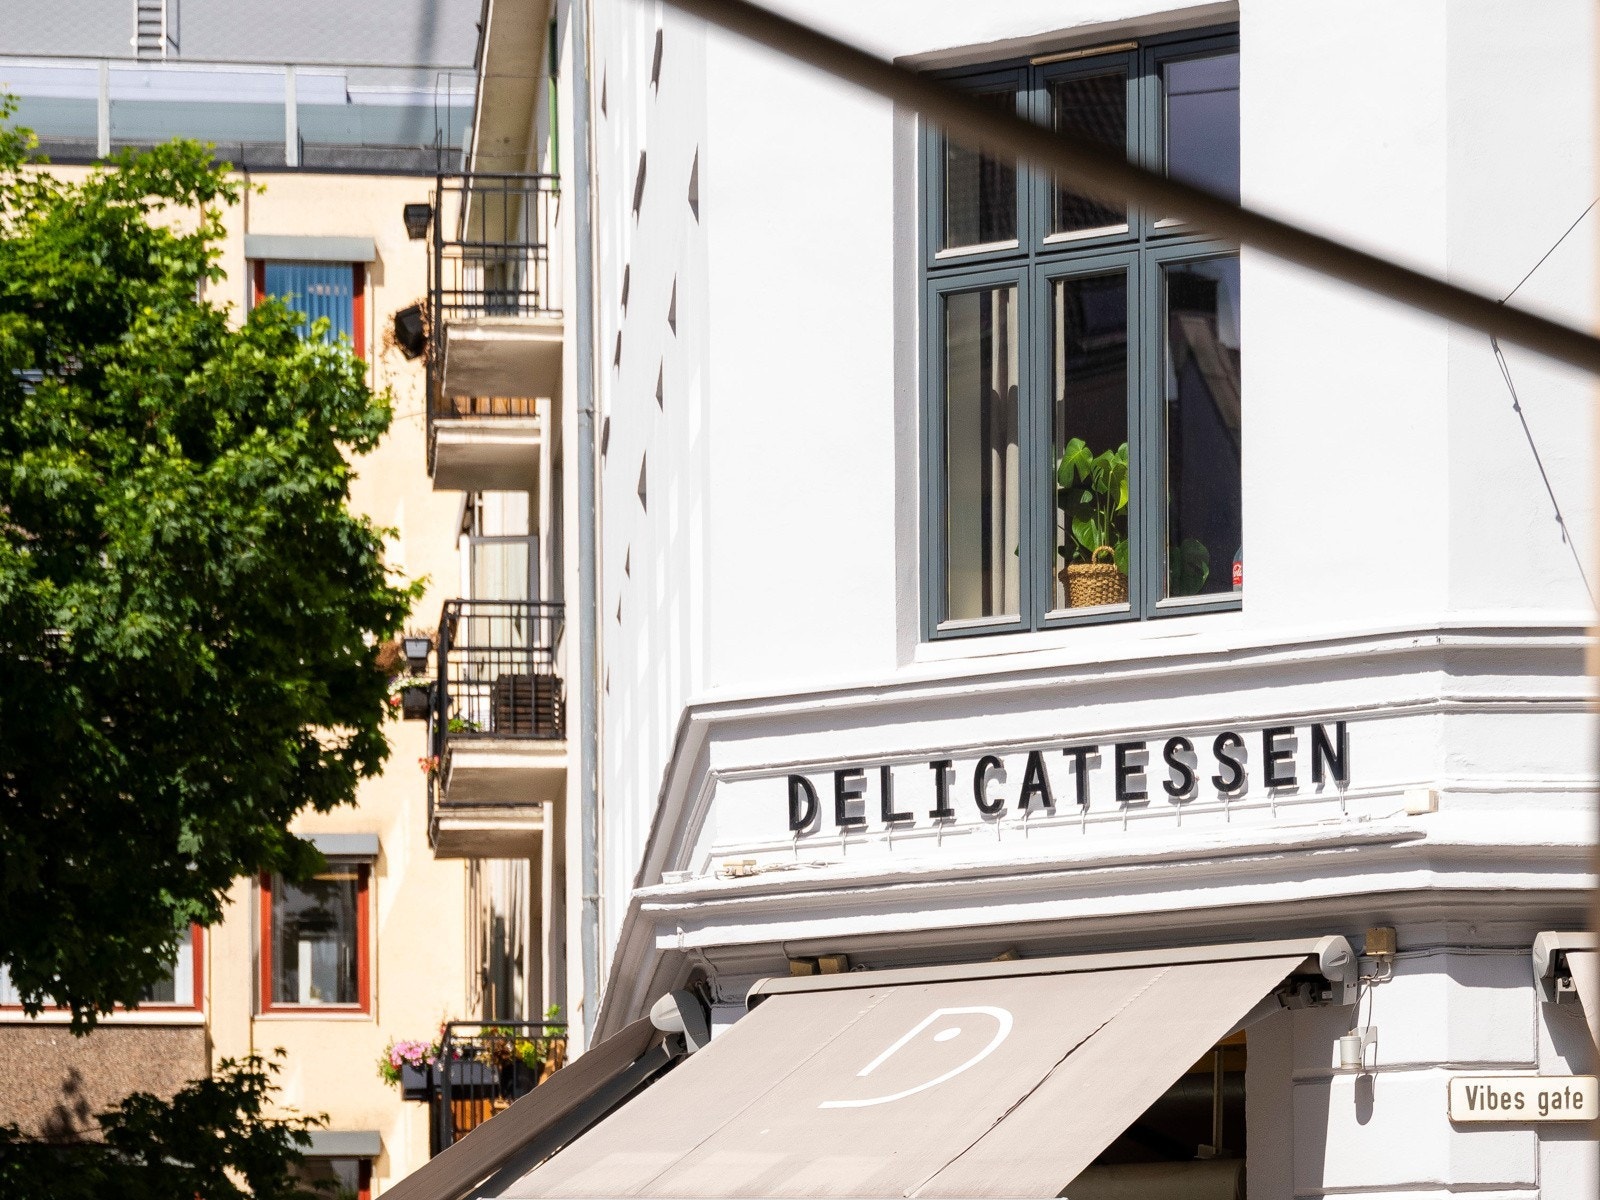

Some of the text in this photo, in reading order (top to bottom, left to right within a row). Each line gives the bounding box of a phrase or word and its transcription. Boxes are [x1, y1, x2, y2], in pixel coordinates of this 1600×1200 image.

[787, 721, 1347, 831] DELICATESSEN
[1465, 1085, 1584, 1117] Vibes gate
